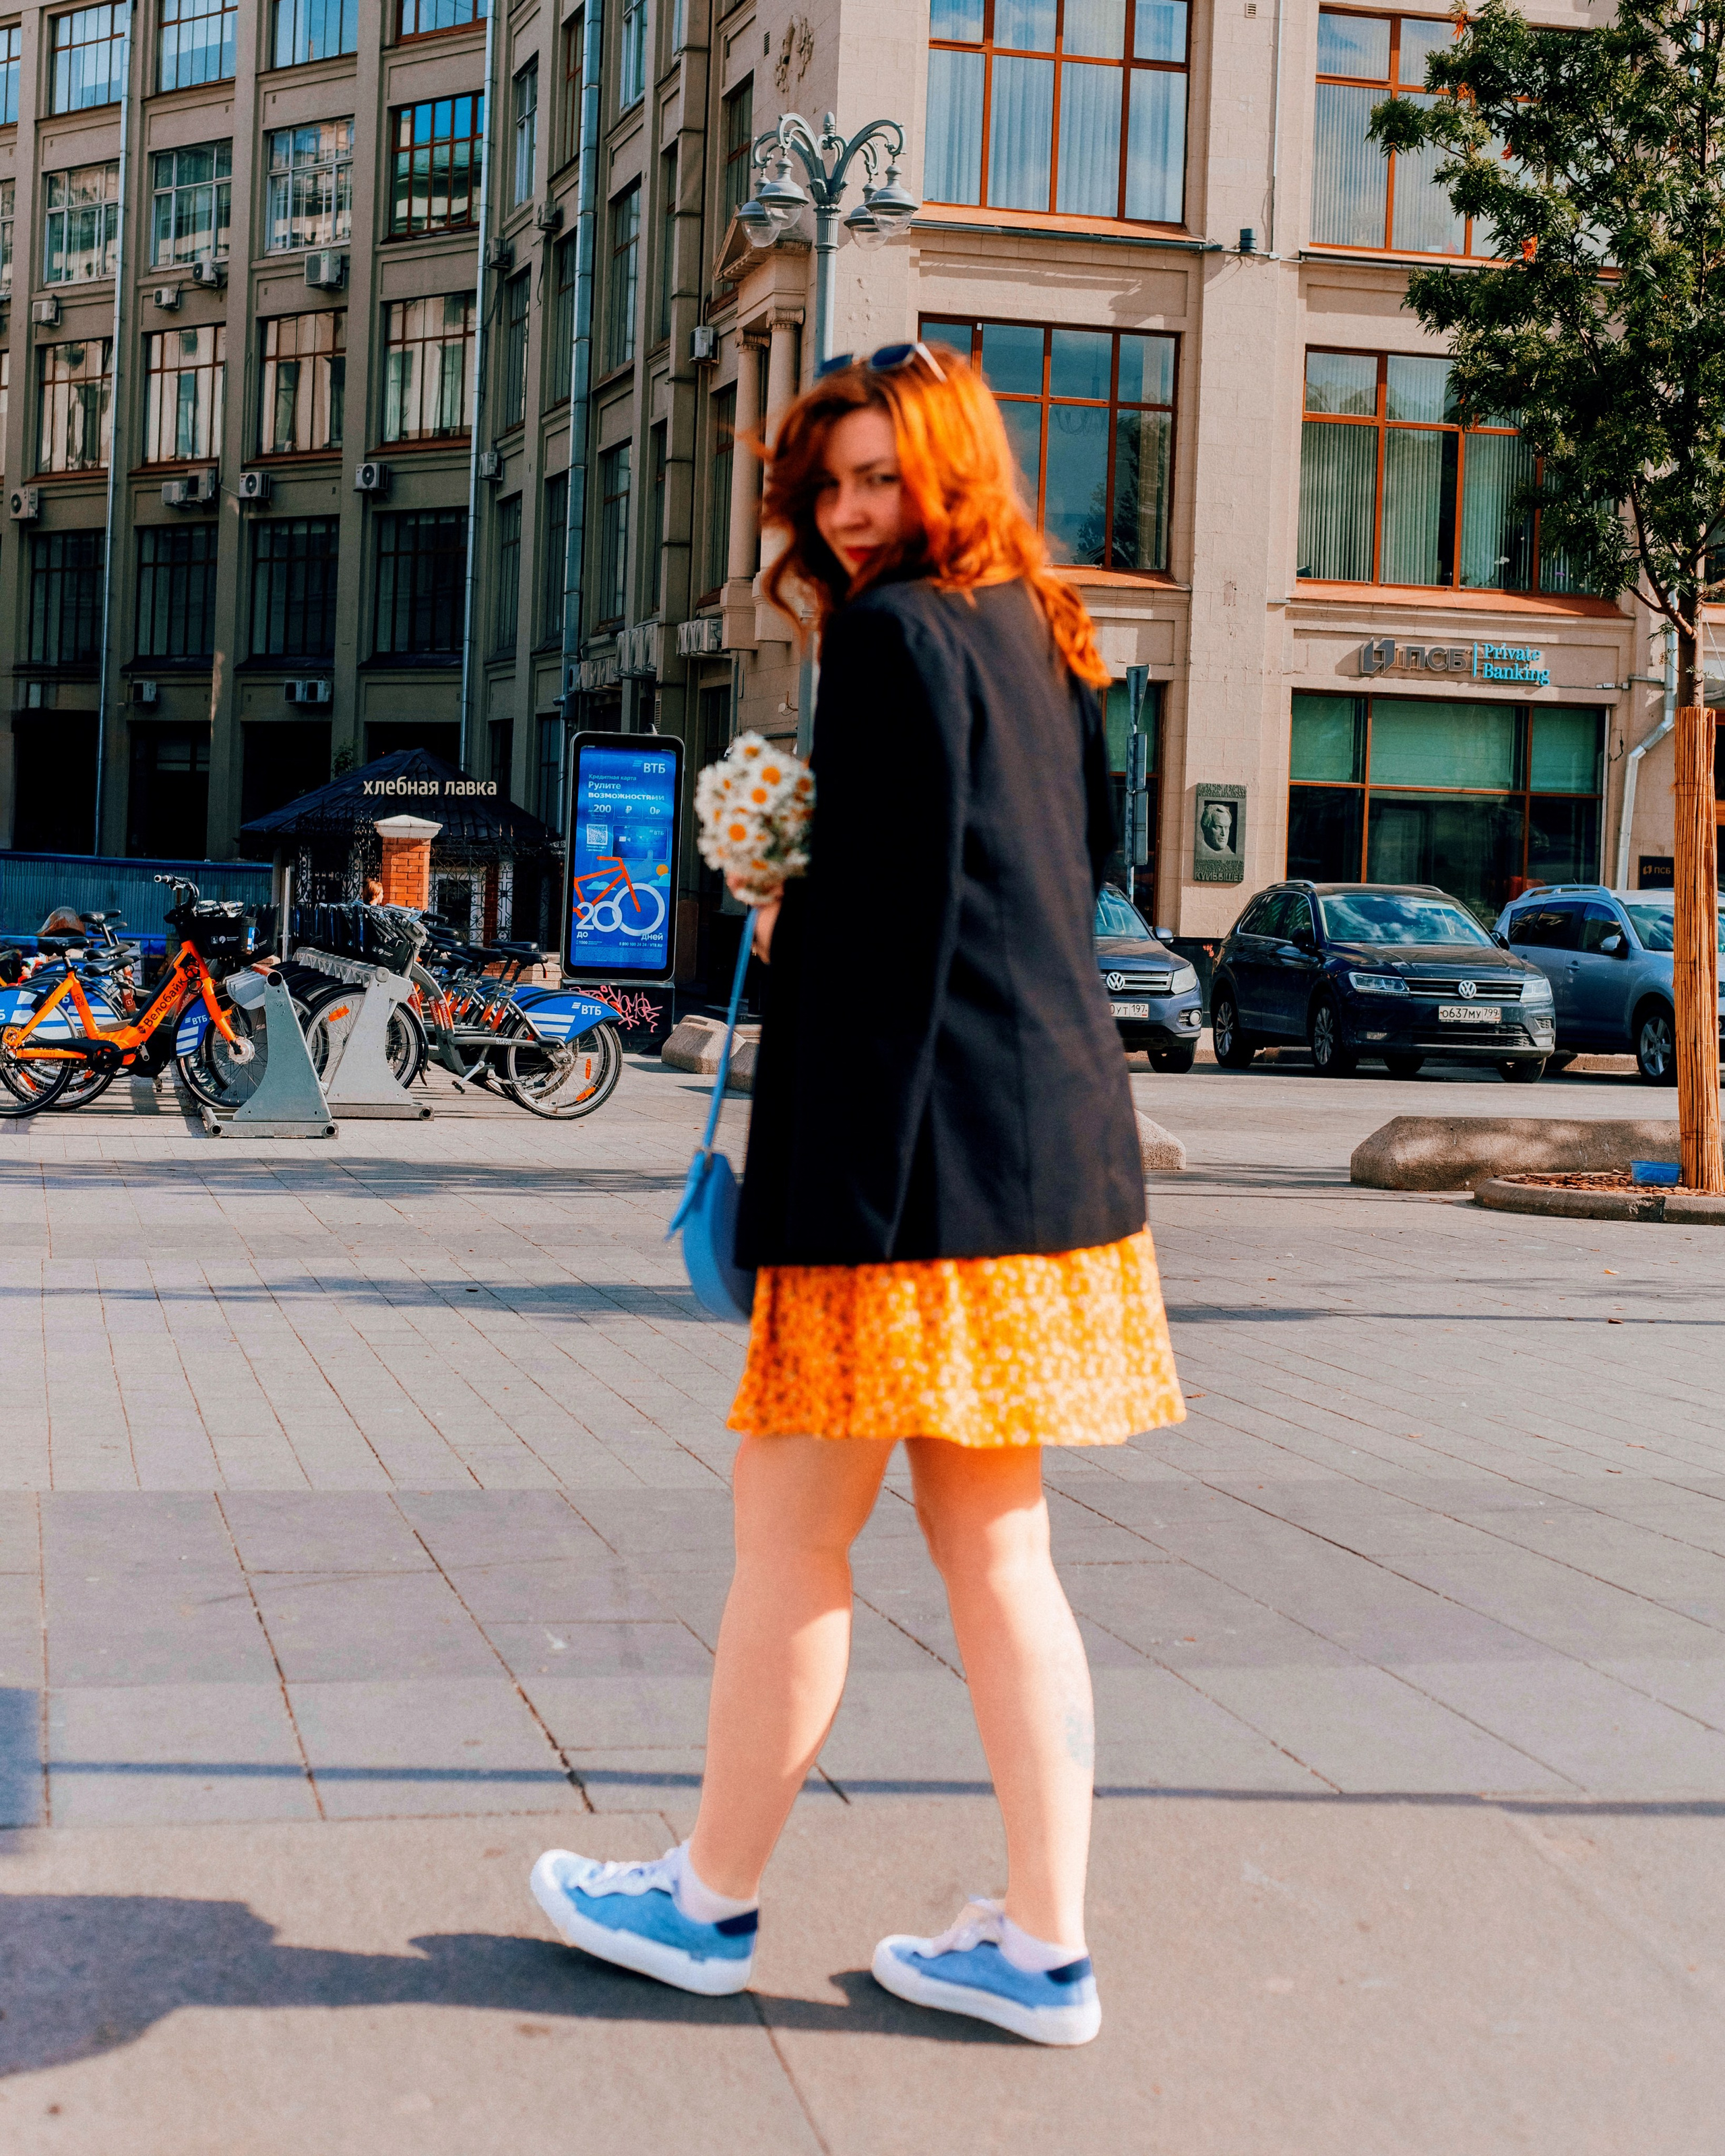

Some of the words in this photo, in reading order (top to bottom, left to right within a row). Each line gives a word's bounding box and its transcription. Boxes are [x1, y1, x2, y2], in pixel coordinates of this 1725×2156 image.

[1483, 642, 1542, 662] Private
[1403, 646, 1467, 672] ПСБ
[1483, 663, 1550, 687] Banking
[644, 762, 666, 774] ВТБ
[363, 775, 439, 796] хлебная
[444, 780, 497, 796] лавка
[588, 781, 621, 790] Рулите
[588, 792, 664, 800] возможностями
[1654, 866, 1671, 875] ПСБ
[641, 933, 664, 941] дней
[143, 978, 185, 1027] Велобайк
[582, 1005, 602, 1016] ВТБ
[1131, 1005, 1146, 1013] 197
[1484, 1009, 1499, 1017] 799
[192, 1015, 208, 1025] ВТБ
